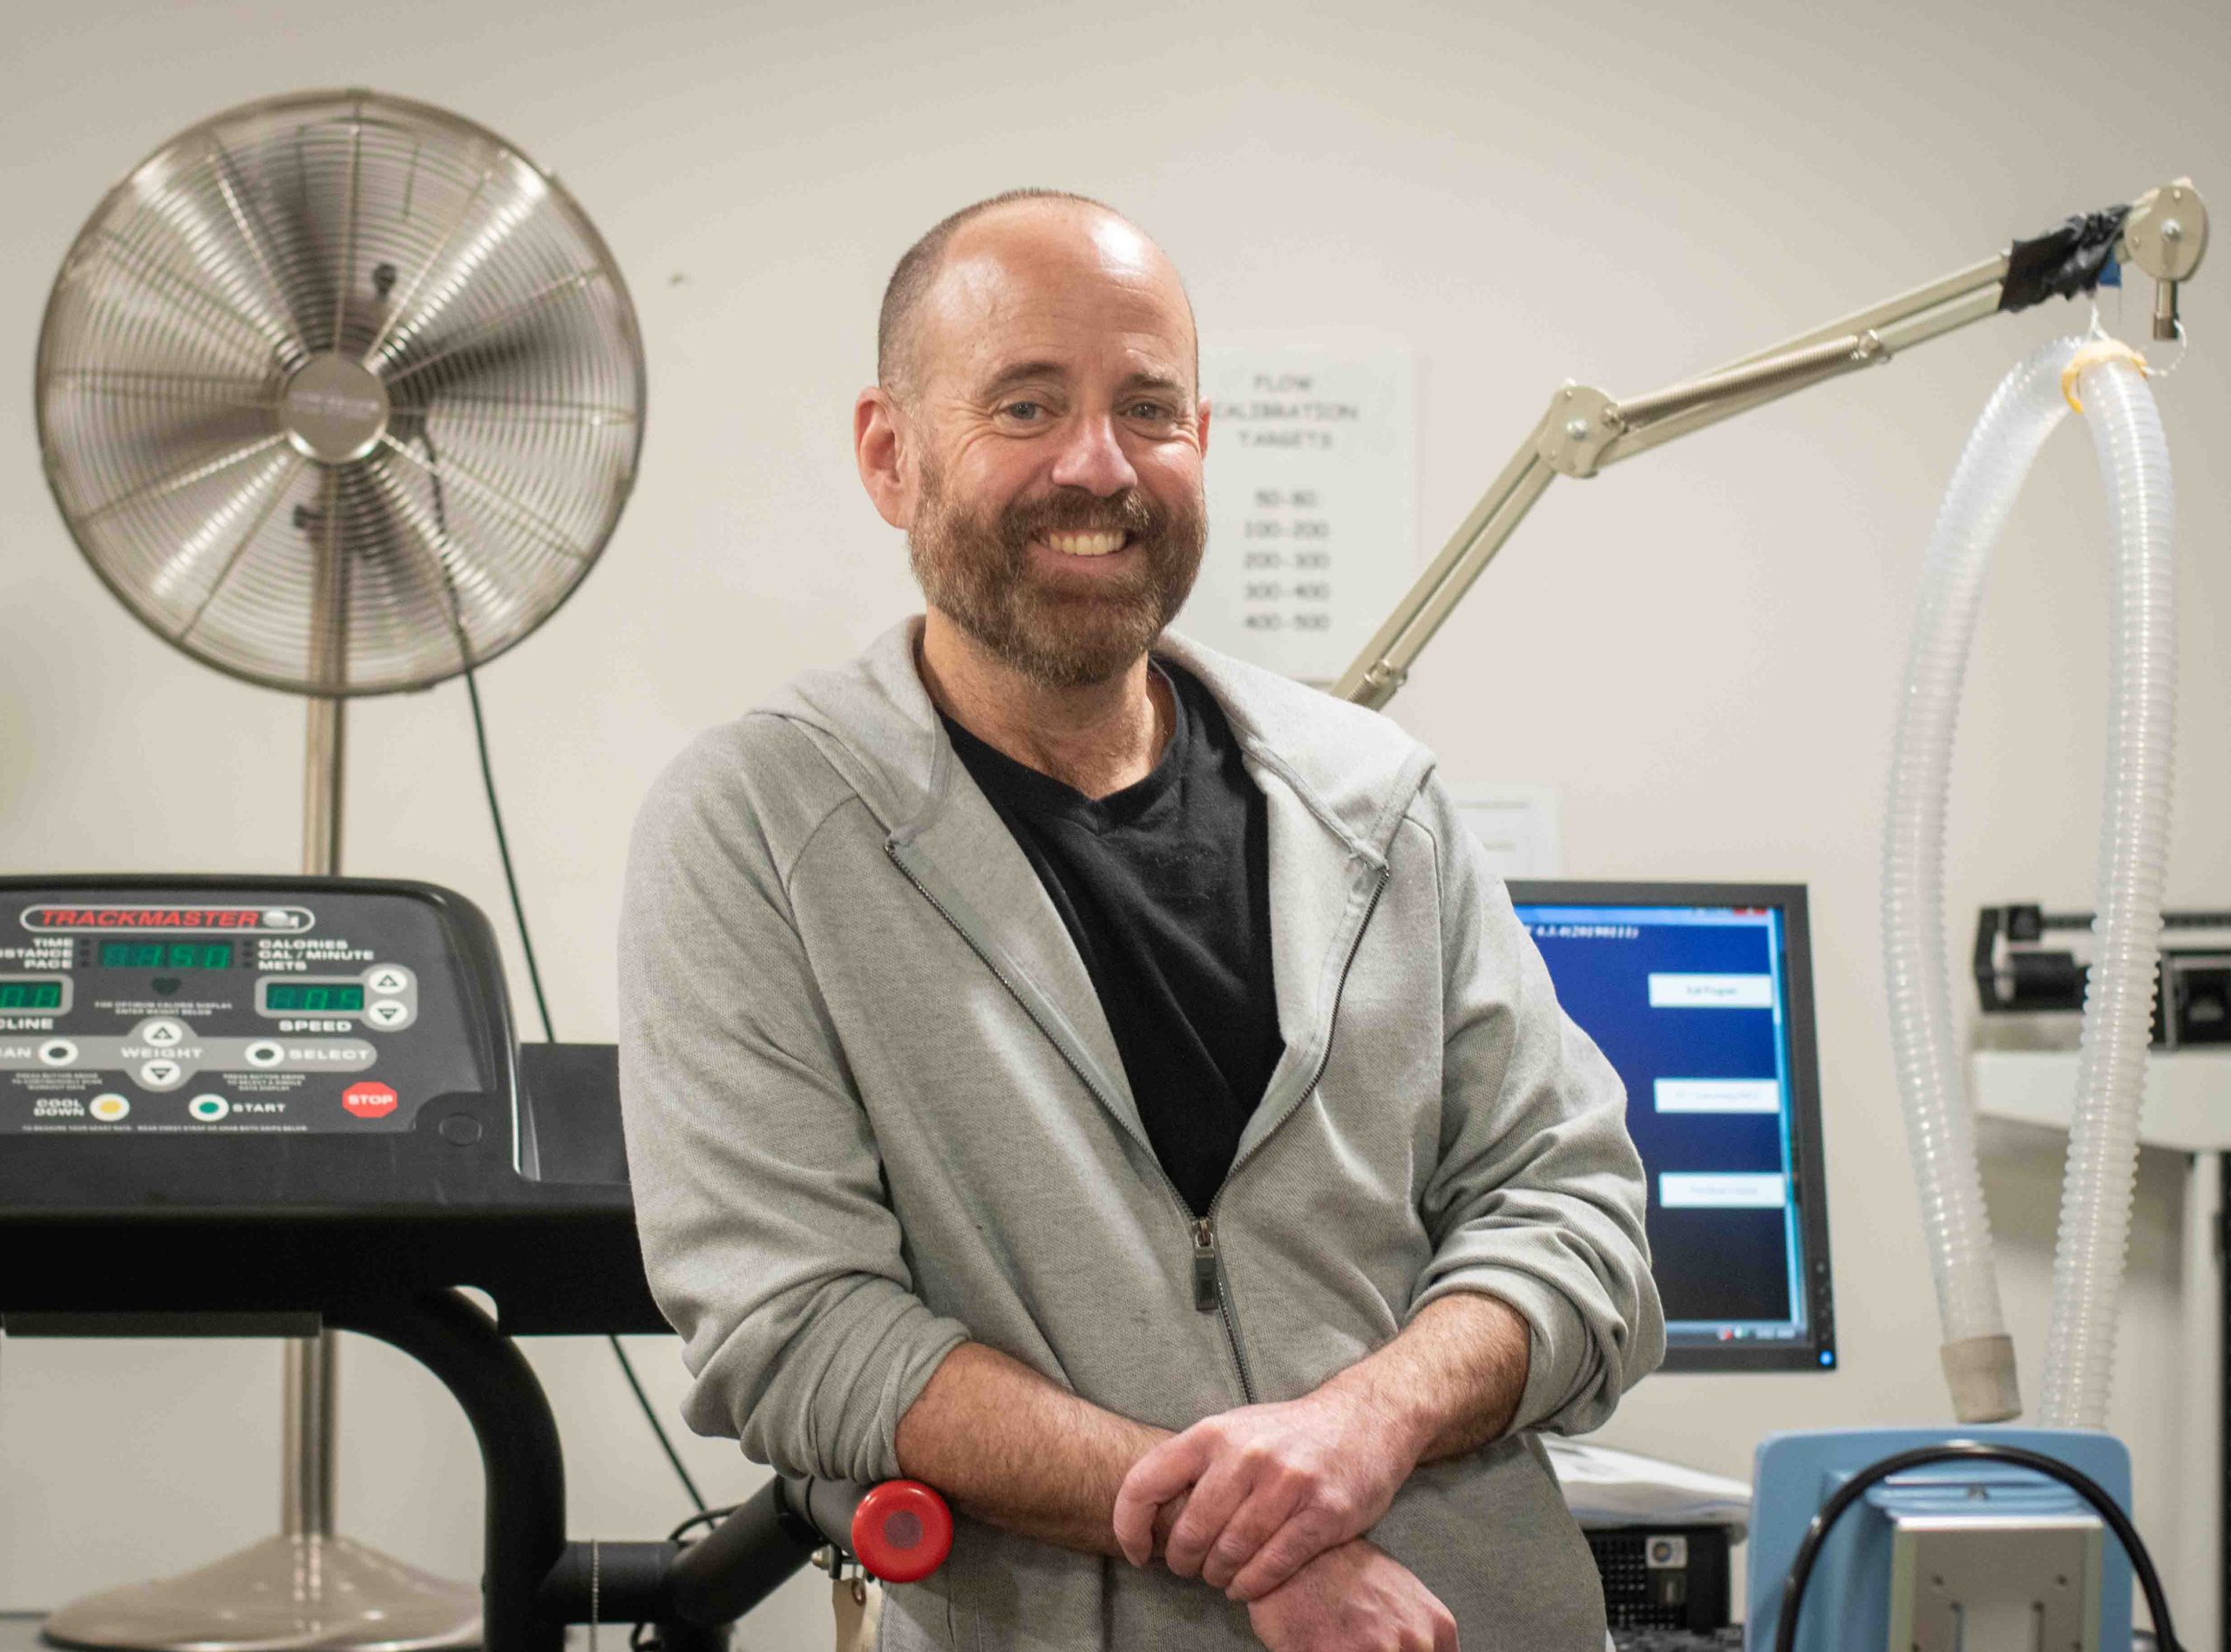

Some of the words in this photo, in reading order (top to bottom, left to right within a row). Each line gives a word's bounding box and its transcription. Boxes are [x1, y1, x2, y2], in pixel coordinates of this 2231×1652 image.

[1239, 432, 1332, 449] TARGETS
[43, 911, 259, 927] TRACKMASTER
[33, 938, 73, 947] TIME
[258, 939, 349, 949] CALORIES
[24, 959, 72, 969] PACE
[258, 960, 308, 971] METS
[279, 1020, 352, 1032] SPEED
[0, 1047, 31, 1058] AN
[121, 1047, 203, 1059] WEIGHT
[288, 1049, 370, 1060] SELECT
[36, 1099, 83, 1107] COOL
[348, 1093, 394, 1105] STOP
[33, 1107, 85, 1116] DOWN
[233, 1103, 286, 1113] START
